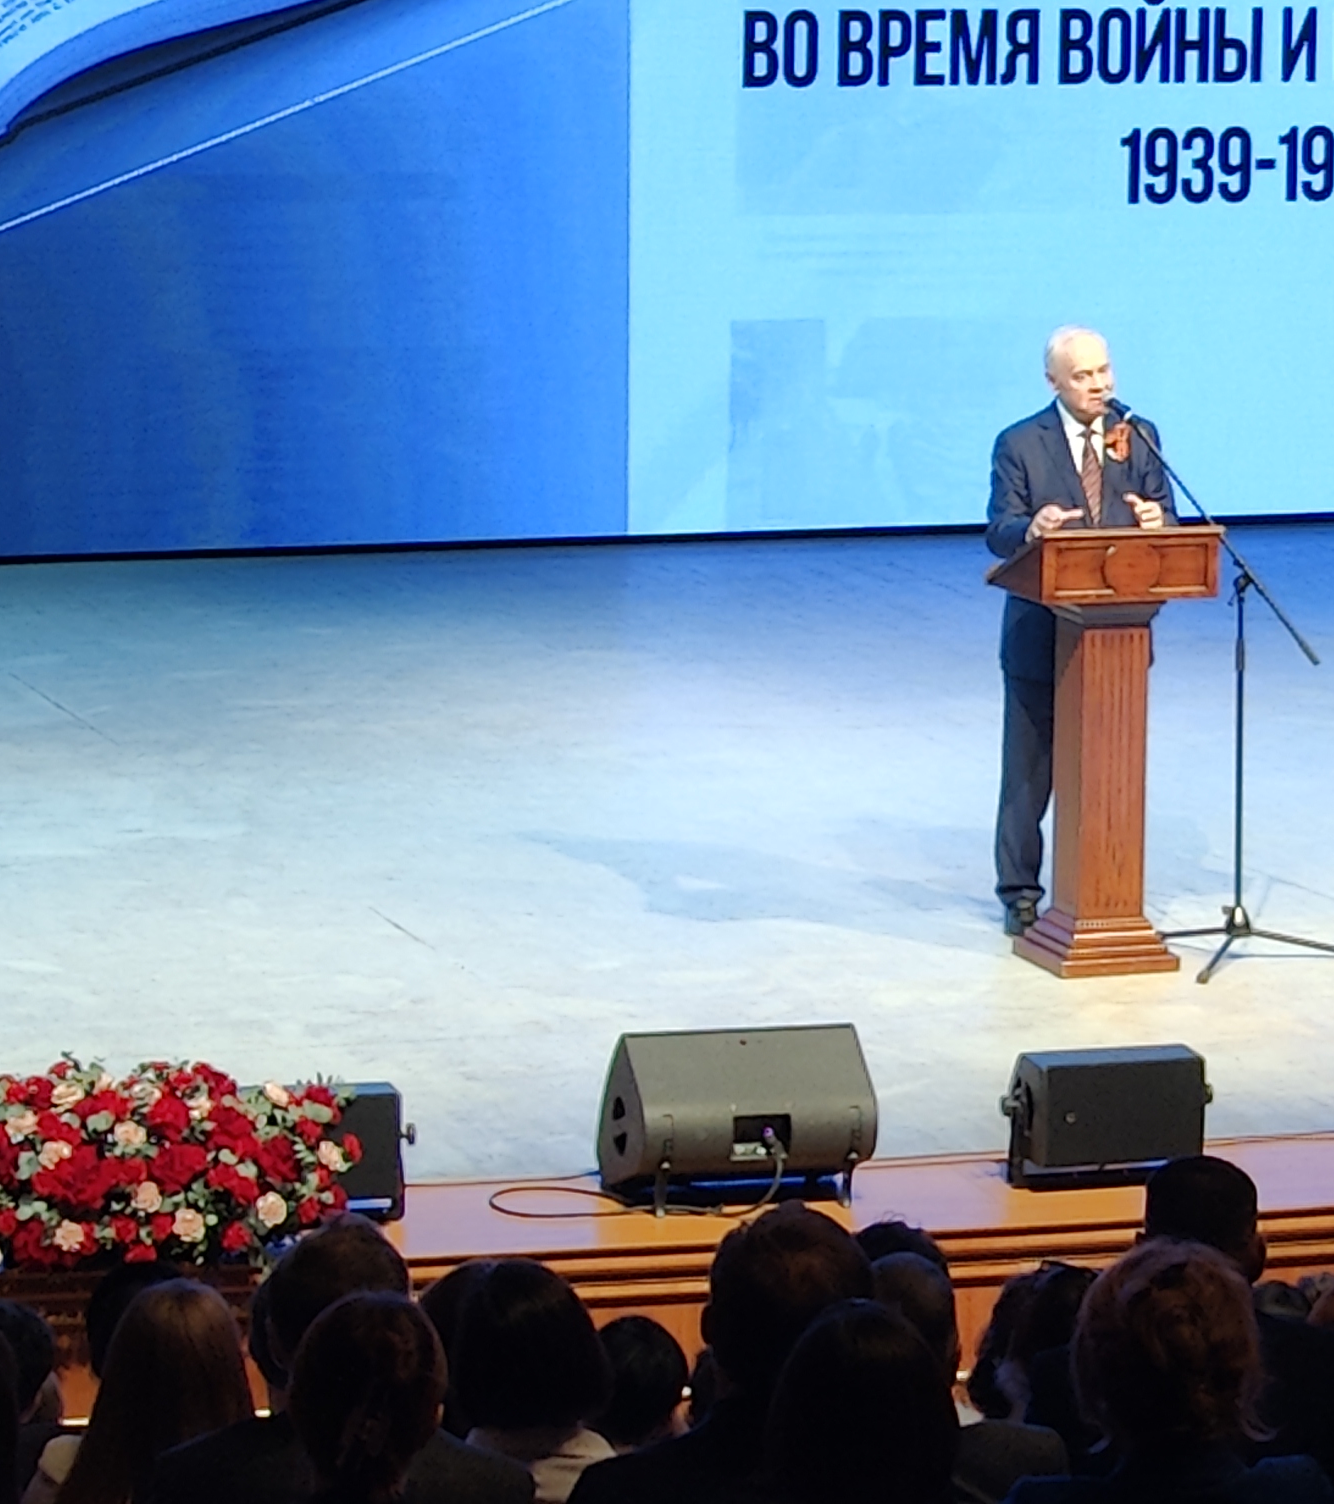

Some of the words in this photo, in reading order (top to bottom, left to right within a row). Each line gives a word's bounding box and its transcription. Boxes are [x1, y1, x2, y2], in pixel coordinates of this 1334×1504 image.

[742, 9, 819, 88] ВО
[837, 8, 1041, 87] ВРЕМЯ
[1281, 6, 1317, 83] И
